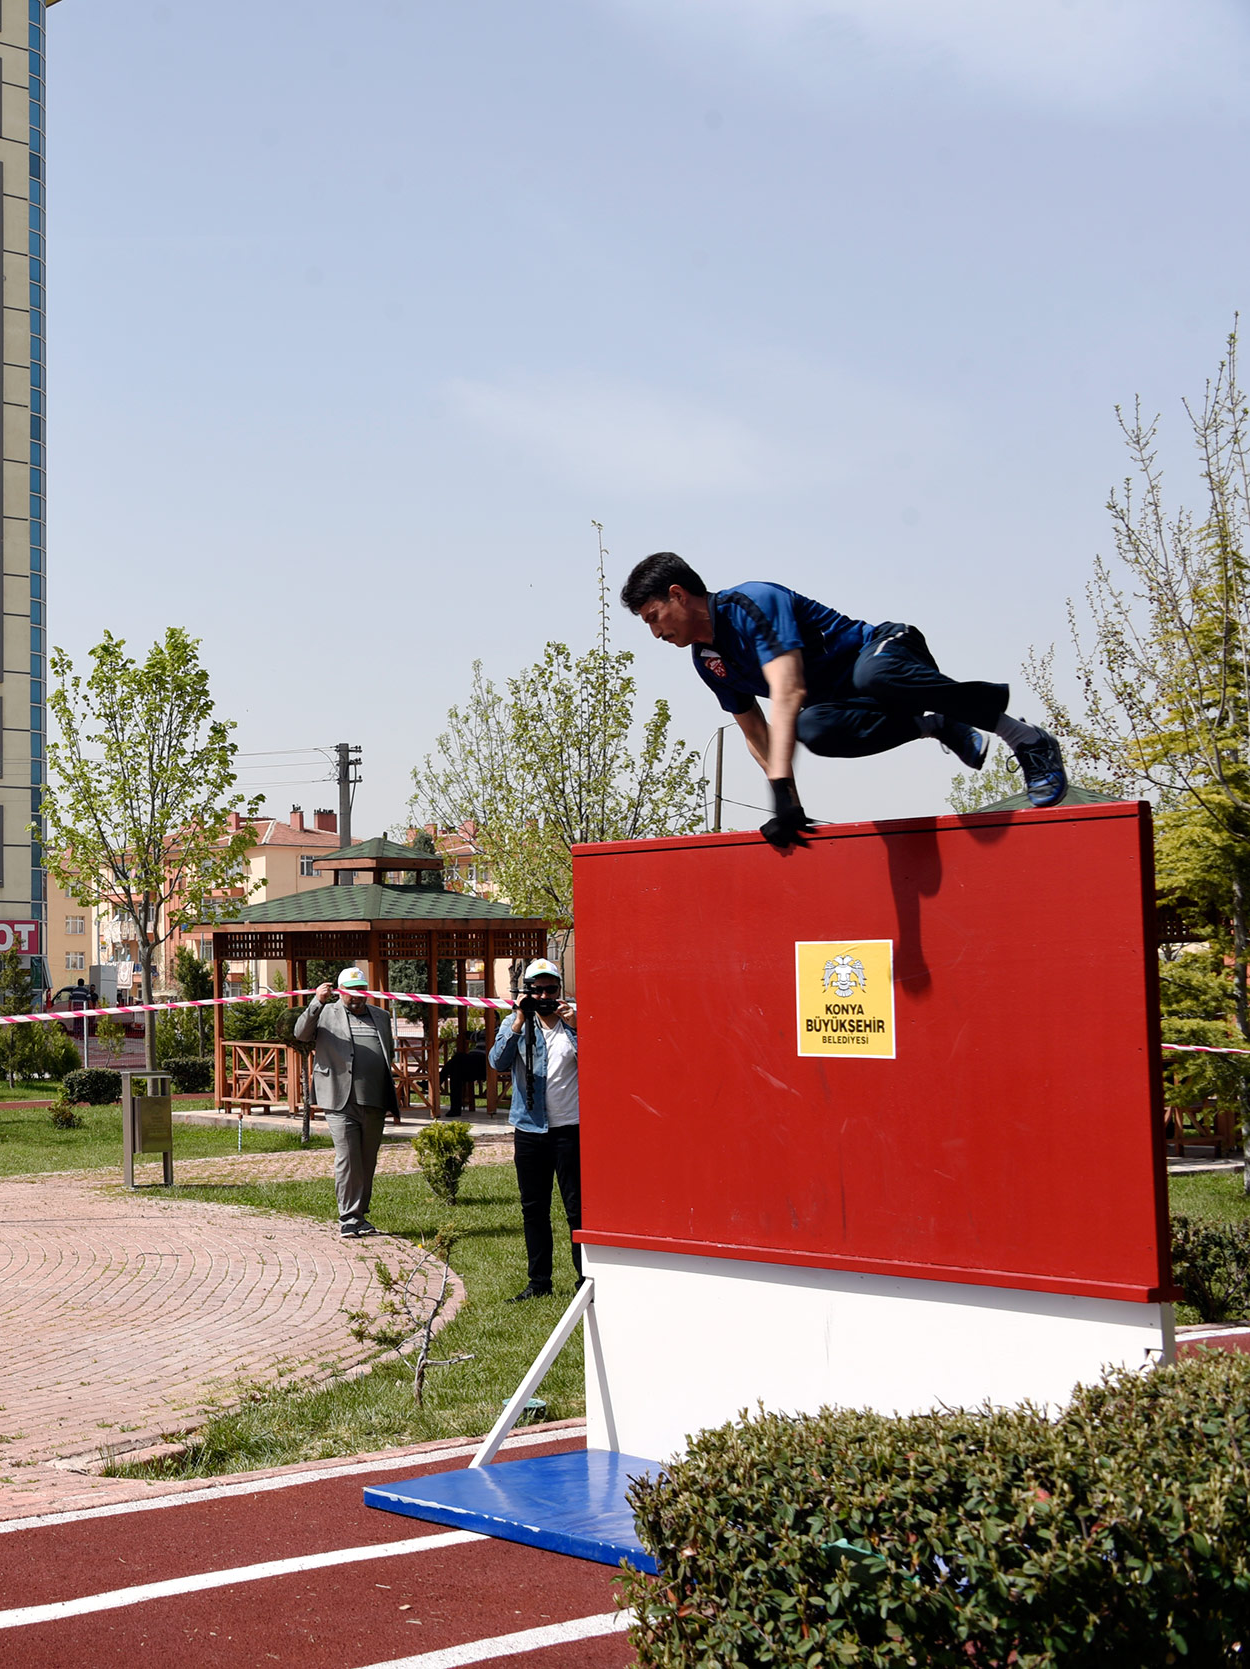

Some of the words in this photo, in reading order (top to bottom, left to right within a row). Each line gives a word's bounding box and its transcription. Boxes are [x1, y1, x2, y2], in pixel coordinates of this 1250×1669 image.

[825, 1004, 865, 1015] KONYA
[805, 1016, 886, 1035] BÜYÜKŞEHİR
[822, 1034, 869, 1044] BELEDİYESİ
